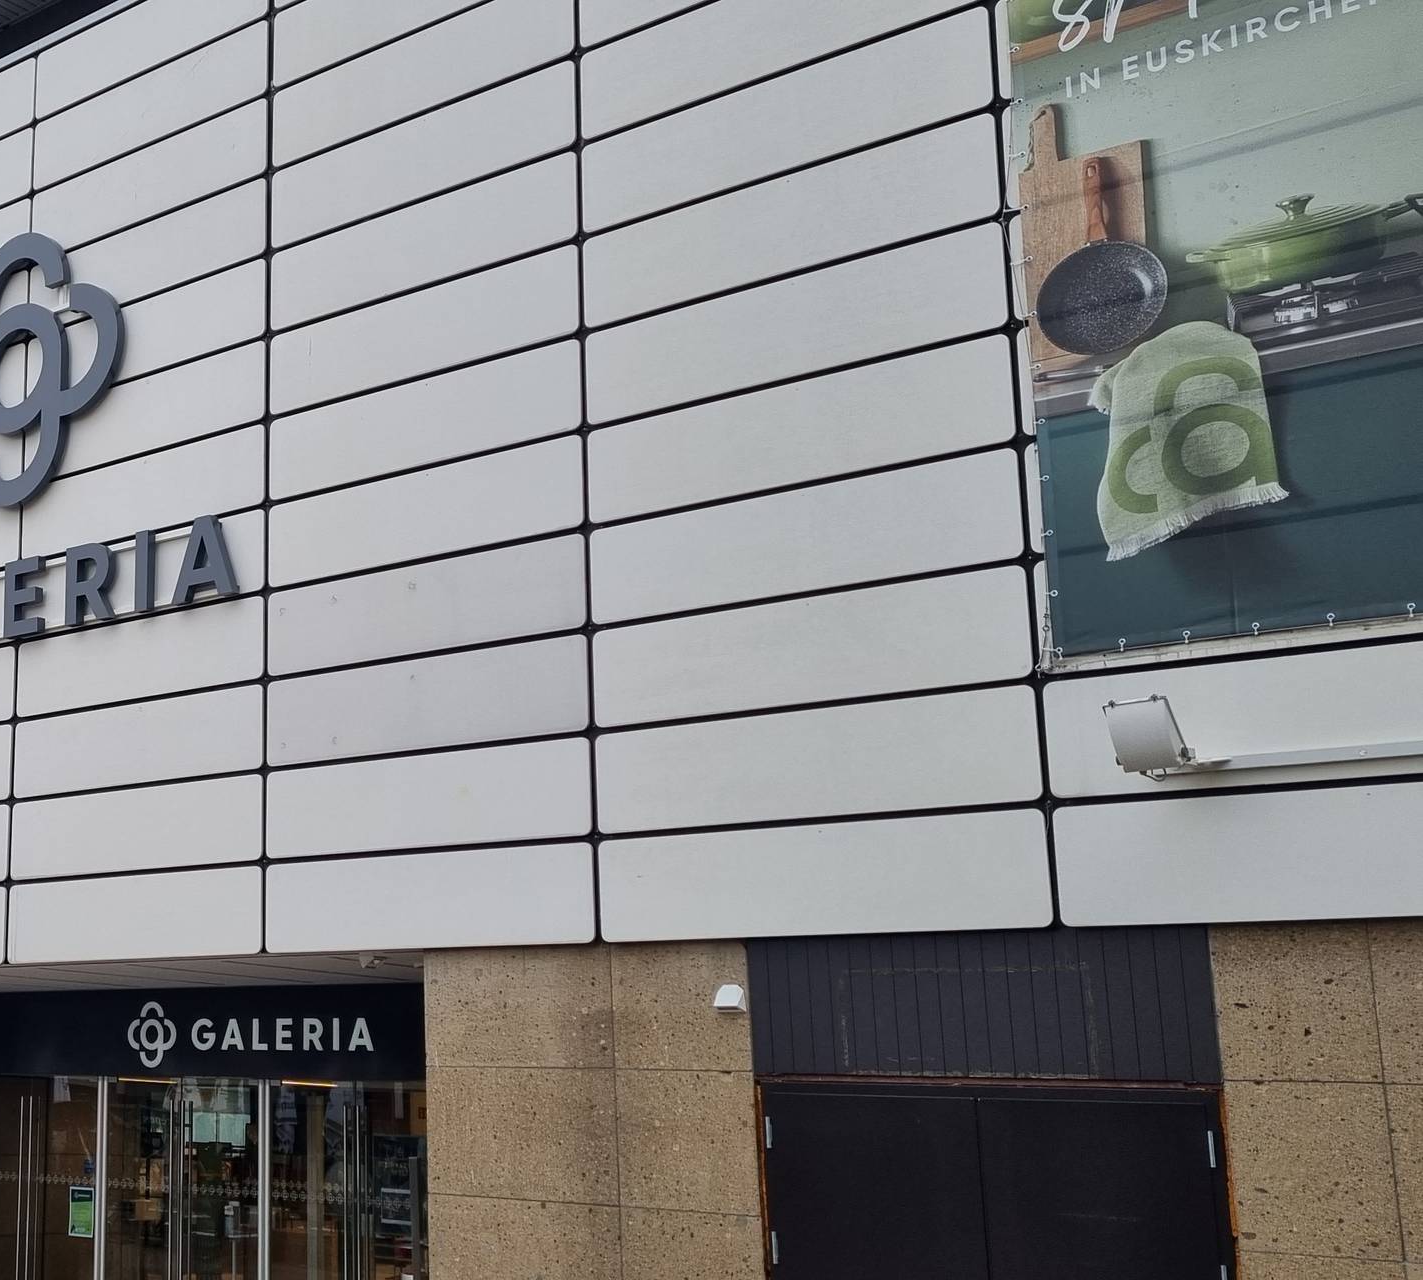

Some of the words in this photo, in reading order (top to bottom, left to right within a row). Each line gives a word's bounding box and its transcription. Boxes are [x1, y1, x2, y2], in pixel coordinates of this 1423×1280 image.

[1065, 68, 1102, 98] IN
[1122, 0, 1377, 80] EUSKIRCHE
[191, 1018, 375, 1051] GALERIA
